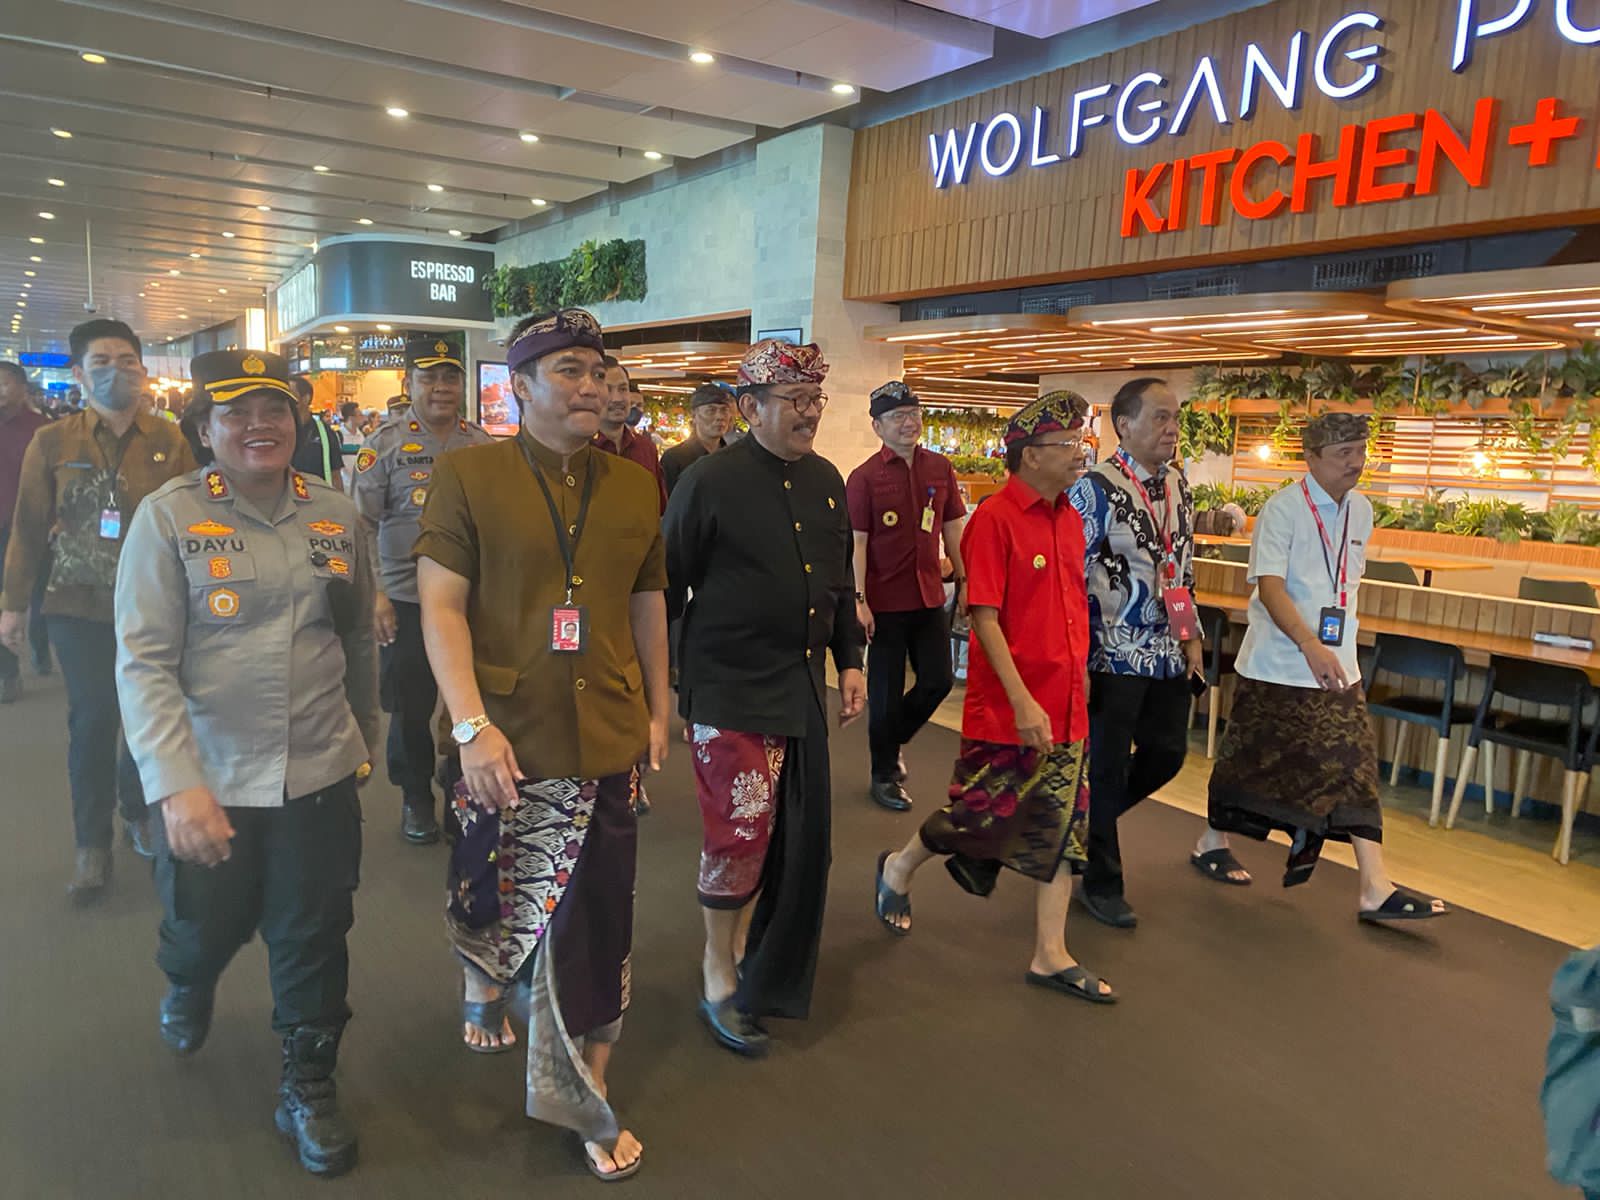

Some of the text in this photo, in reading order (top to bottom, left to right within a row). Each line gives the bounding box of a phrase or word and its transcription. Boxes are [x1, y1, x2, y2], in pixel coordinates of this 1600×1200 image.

[929, 13, 1385, 189] WOLFGANG
[1120, 96, 1496, 237] KITCHEN
[410, 260, 475, 283] ESPRESSO
[430, 282, 457, 302] BAR
[186, 538, 245, 553] DAYU
[1172, 602, 1185, 612] VIP
